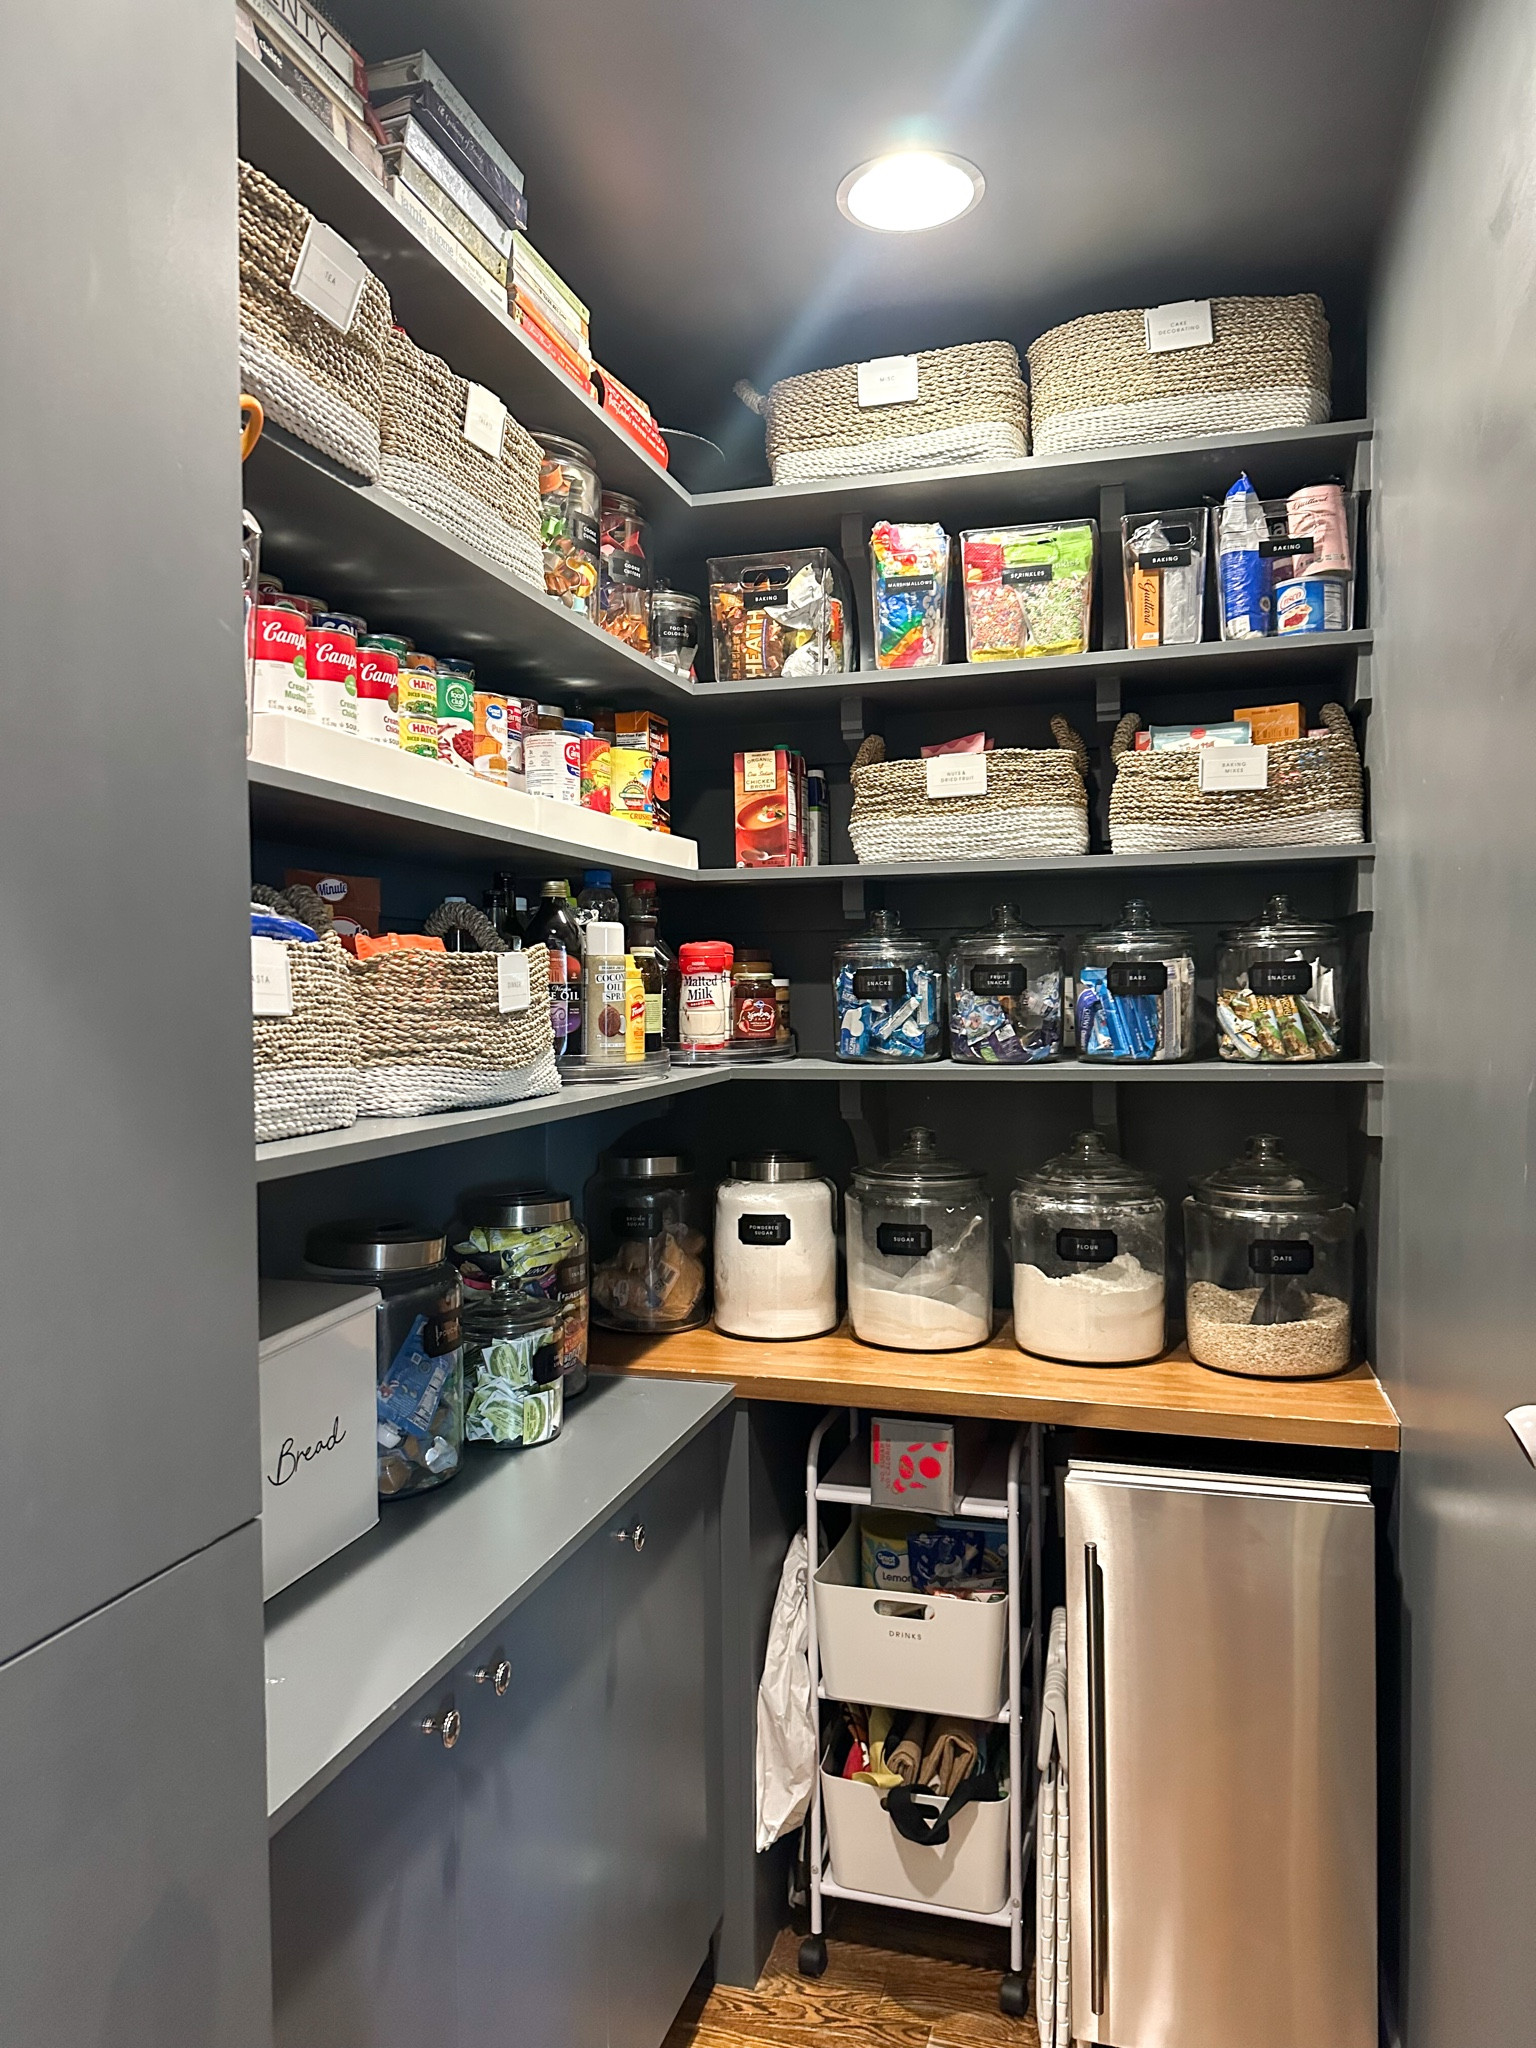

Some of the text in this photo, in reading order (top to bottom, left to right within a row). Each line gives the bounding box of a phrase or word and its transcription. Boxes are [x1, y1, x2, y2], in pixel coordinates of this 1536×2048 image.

[432, 225, 455, 257] home
[324, 271, 336, 286] TEA
[1170, 320, 1188, 328] CAKE
[1158, 324, 1201, 336] DECORATING
[1273, 543, 1302, 552] BAKING
[1152, 555, 1179, 564] BAKING
[1010, 570, 1046, 579] SPRINKLES
[887, 579, 934, 588] MARSHMALLOWS
[754, 594, 779, 603] BAKING
[744, 609, 766, 678] HEATH
[450, 691, 465, 700] food
[450, 697, 465, 708] club
[746, 756, 773, 764] ORGANIC
[316, 881, 348, 897] Minute
[683, 974, 718, 987] Malted
[606, 983, 622, 991] OIL
[560, 991, 580, 1001] OIL
[687, 987, 713, 1001] Milk
[1076, 1243, 1099, 1251] FLOUR
[1272, 1254, 1293, 1262] OATS
[266, 1415, 347, 1487] Bread
[888, 1630, 922, 1641] DRINKS
